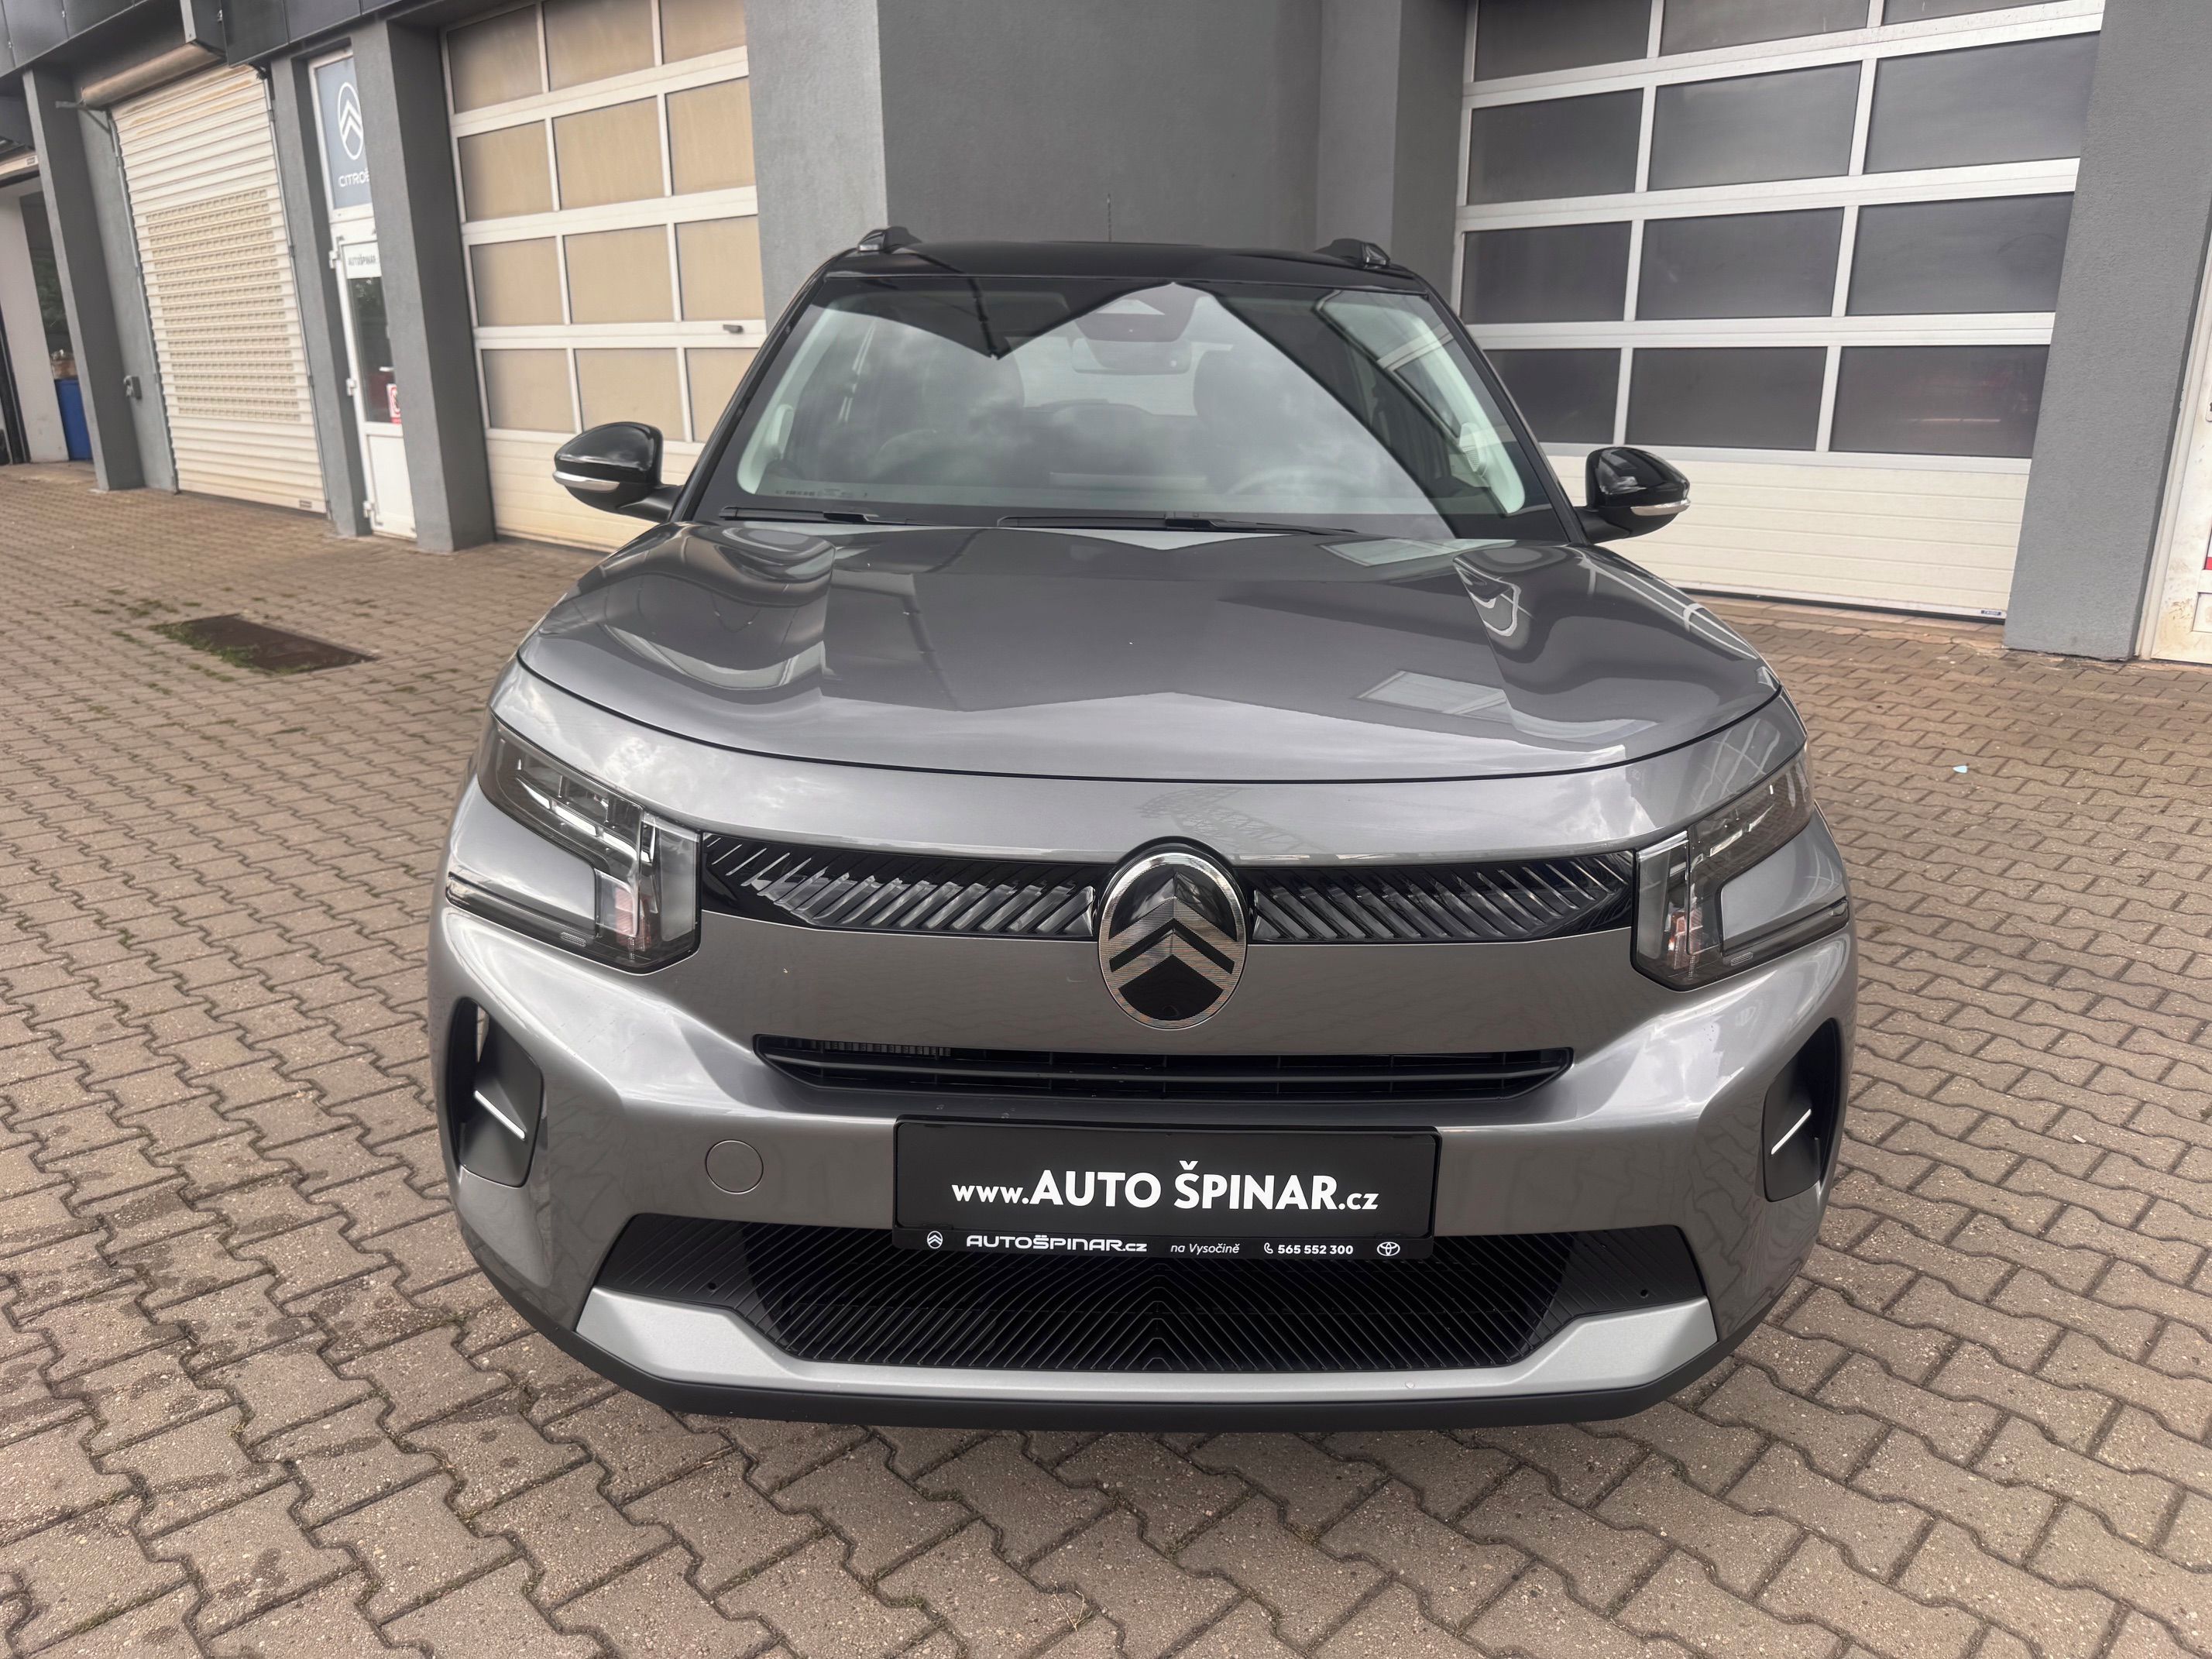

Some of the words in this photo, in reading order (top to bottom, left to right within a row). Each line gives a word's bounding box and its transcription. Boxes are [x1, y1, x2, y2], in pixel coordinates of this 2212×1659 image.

[951, 1170, 1162, 1208] www.AUTO
[1173, 1160, 1379, 1210] ŠPINAR.cz
[966, 1234, 1148, 1252] AUTOŠPINAR.cz
[1170, 1244, 1185, 1253] na
[1189, 1242, 1240, 1255] Vysočině
[1277, 1244, 1301, 1255] 565
[1304, 1245, 1327, 1255] 552
[1329, 1245, 1354, 1255] 300
